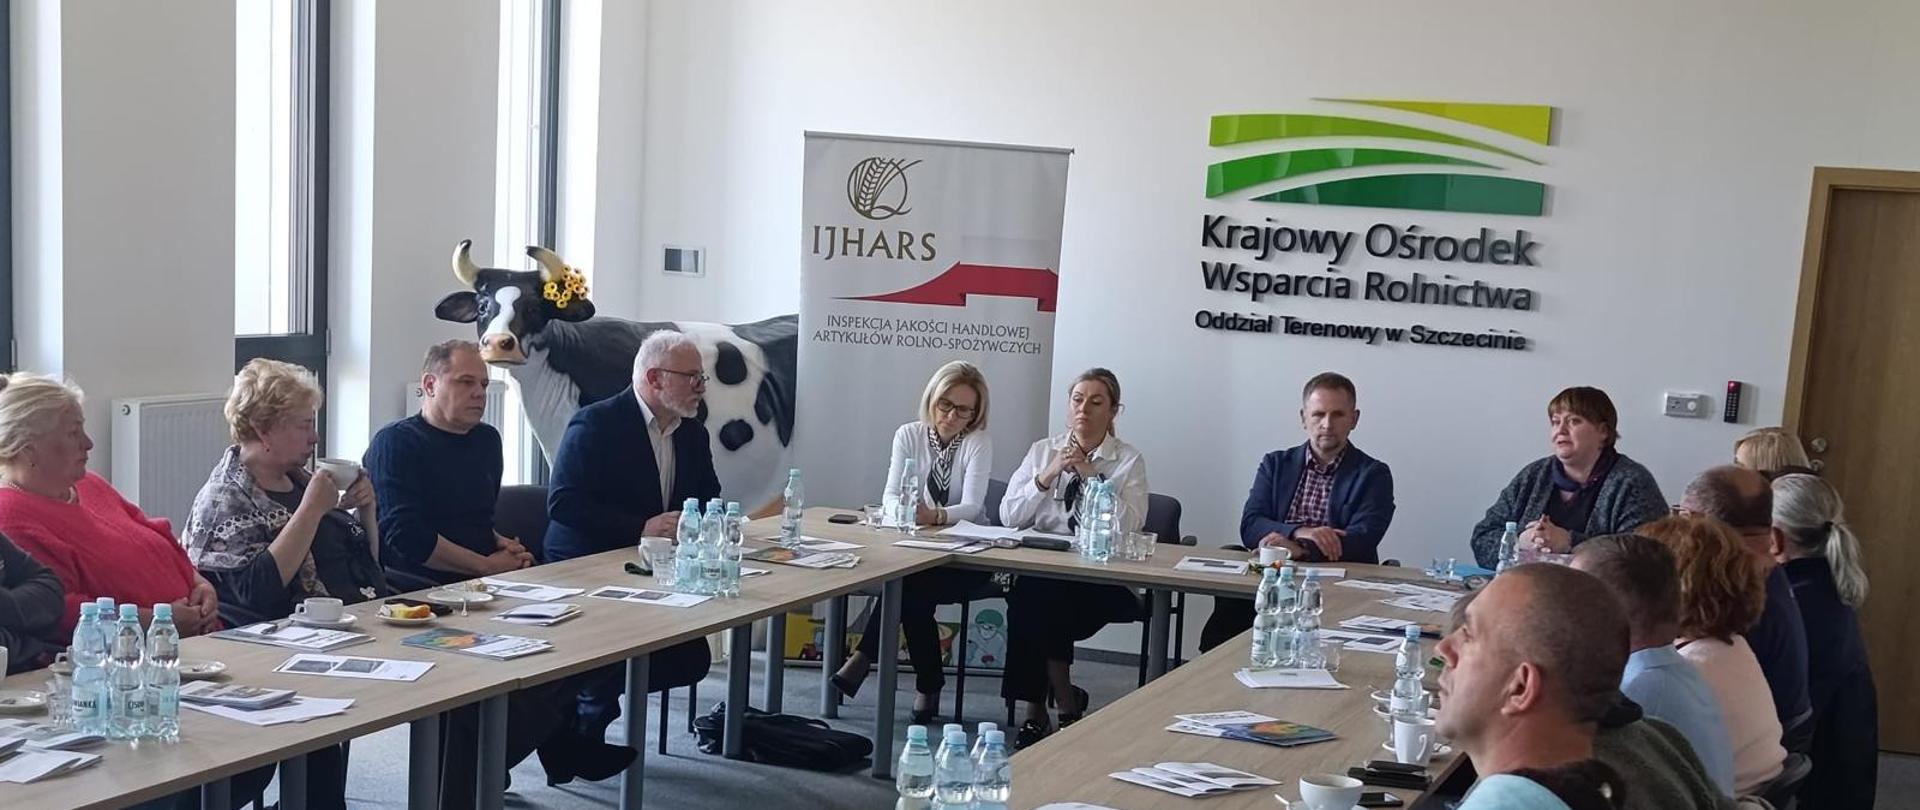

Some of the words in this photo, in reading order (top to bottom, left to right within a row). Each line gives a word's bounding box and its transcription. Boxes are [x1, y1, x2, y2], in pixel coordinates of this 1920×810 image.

[812, 225, 937, 261] IJHARS
[1201, 215, 1354, 264] Krajowy
[1364, 223, 1537, 266] Ośrodek
[1201, 261, 1352, 301] Wsparcia
[1363, 271, 1533, 311] Rolnictwa
[812, 330, 893, 347] ARTYKUŁÓW
[827, 314, 892, 332] INSPEKCJA
[896, 318, 948, 334] JAKOŚCI
[952, 323, 1030, 339] HANDLOWEJ
[1194, 310, 1274, 333] Oddział
[1280, 315, 1380, 345] Terenowy
[1385, 327, 1404, 342] w
[1410, 325, 1527, 350] Szczecinie
